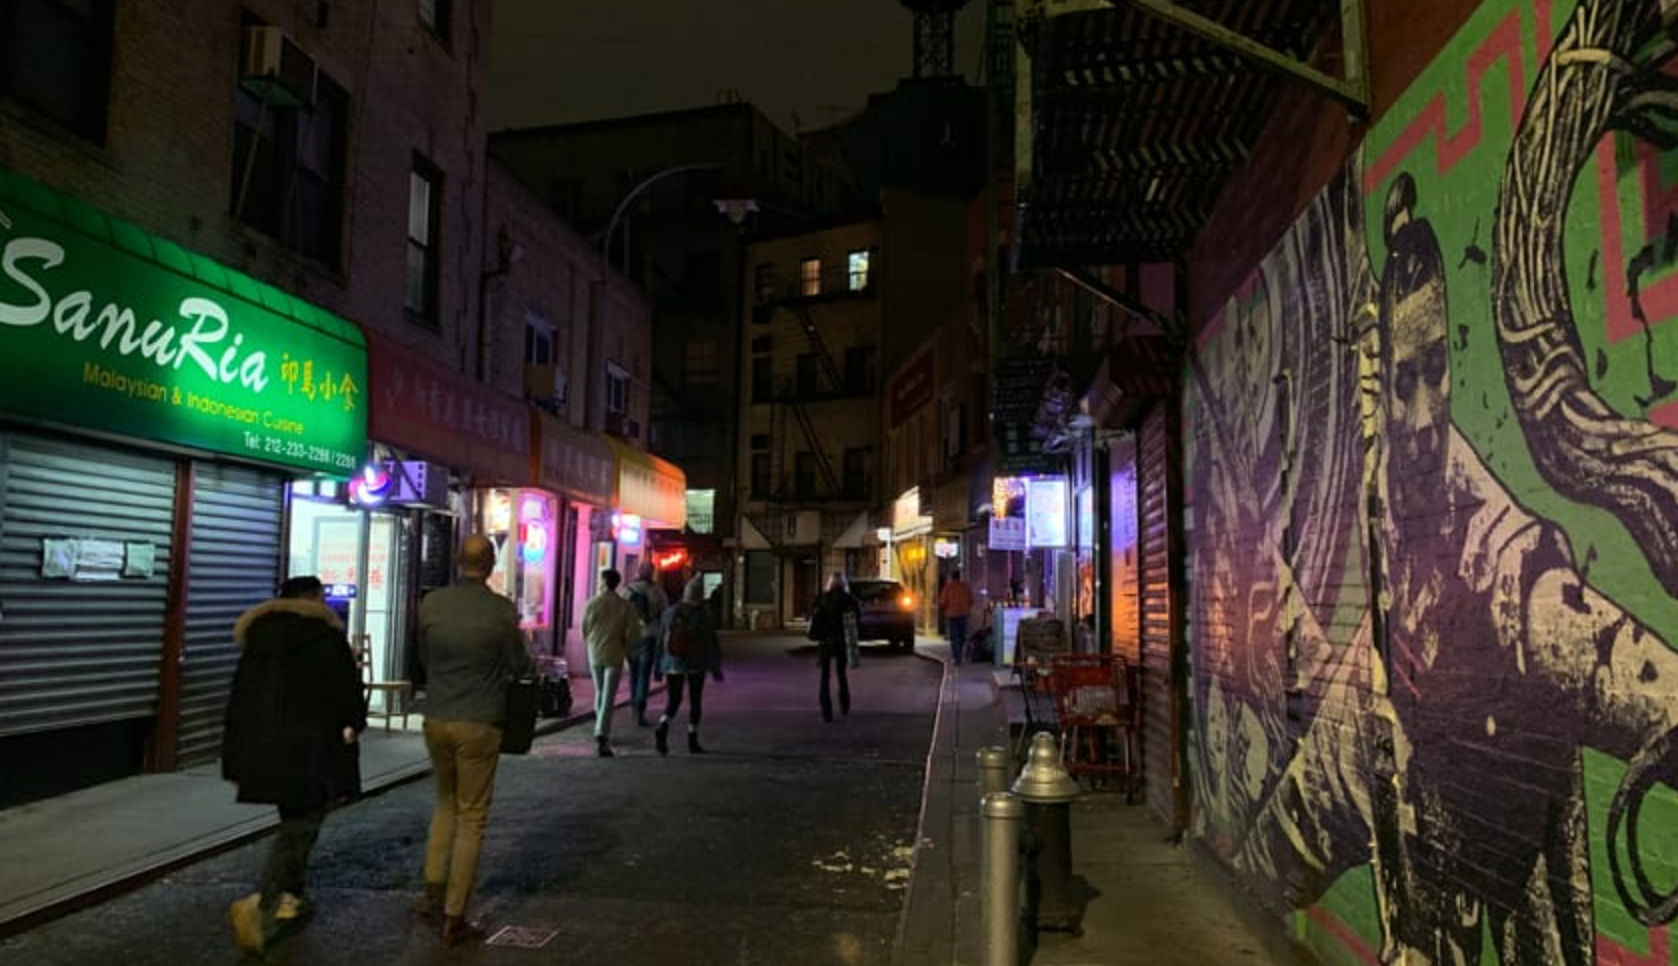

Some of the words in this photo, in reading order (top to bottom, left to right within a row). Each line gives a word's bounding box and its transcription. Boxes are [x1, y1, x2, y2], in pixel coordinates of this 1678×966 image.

[0, 237, 269, 393] SanuRia
[83, 362, 167, 402] Malaysian
[171, 386, 182, 405] &
[187, 391, 259, 424] Indonesian
